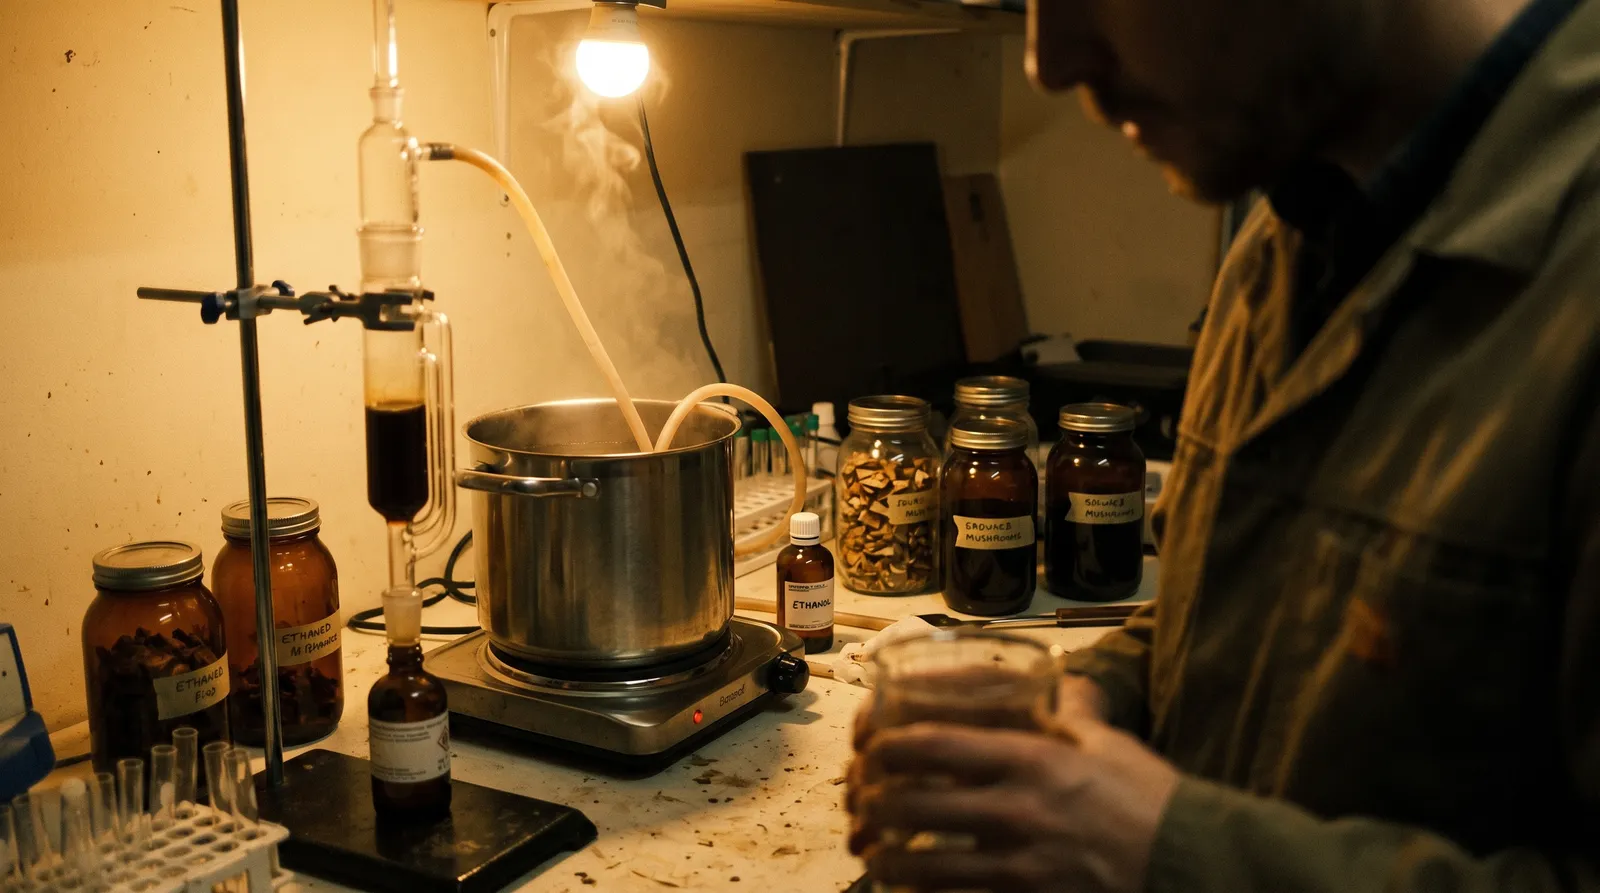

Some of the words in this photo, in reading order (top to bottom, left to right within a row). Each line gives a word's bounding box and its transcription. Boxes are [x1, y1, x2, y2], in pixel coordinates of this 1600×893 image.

[792, 598, 832, 610] ETHANOL
[281, 622, 332, 645] ETHANED
[175, 666, 224, 693] ETHANED
